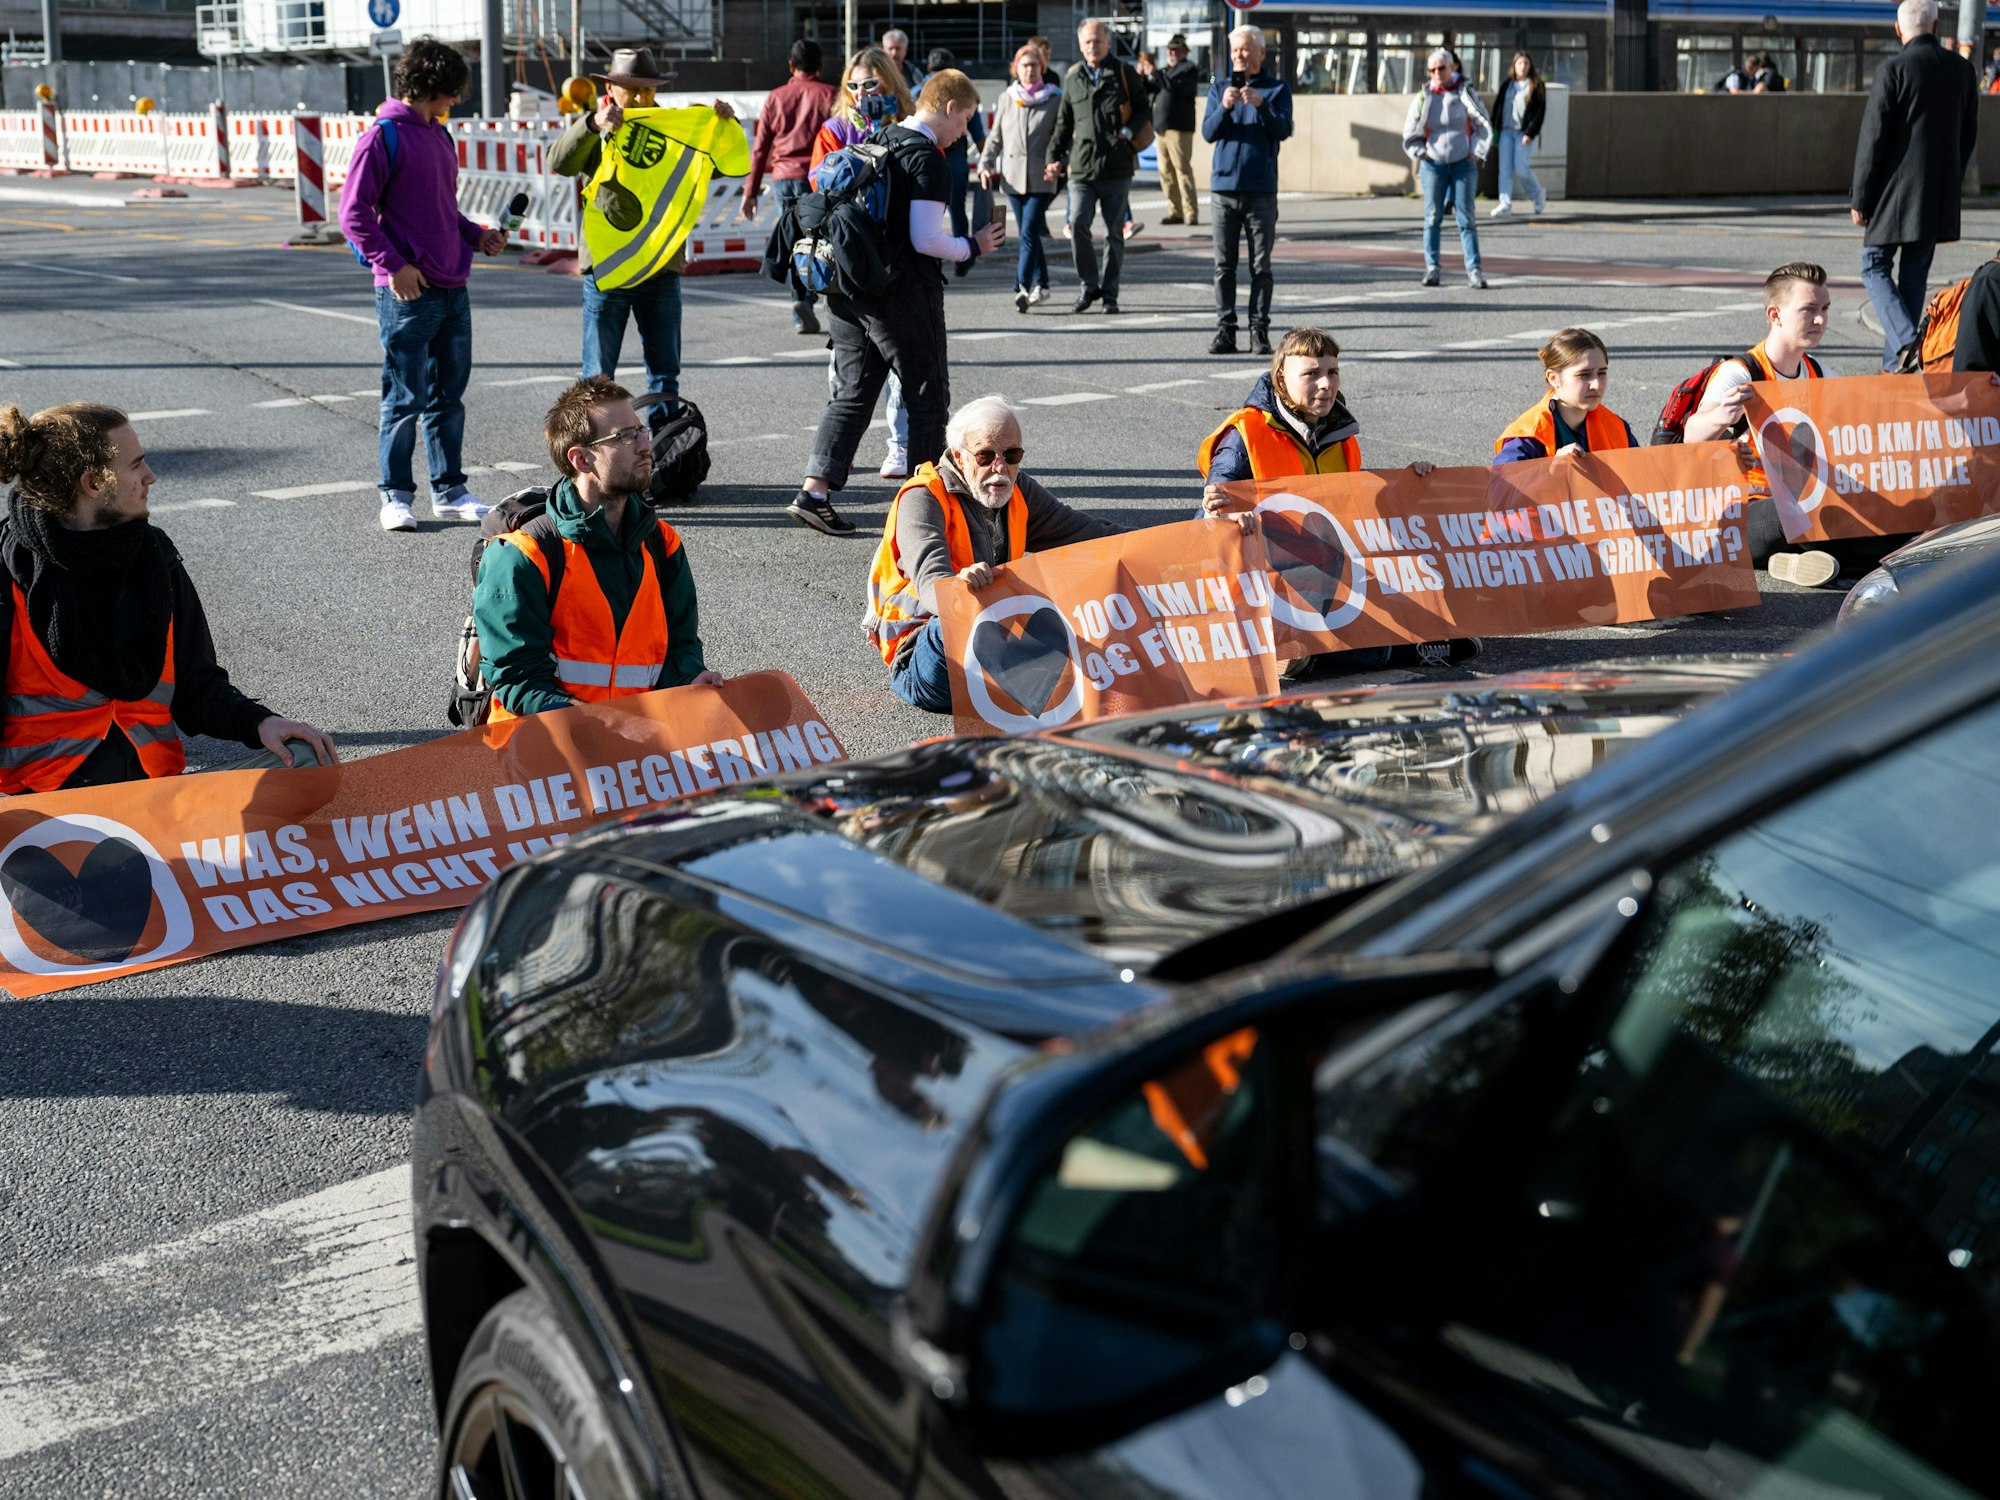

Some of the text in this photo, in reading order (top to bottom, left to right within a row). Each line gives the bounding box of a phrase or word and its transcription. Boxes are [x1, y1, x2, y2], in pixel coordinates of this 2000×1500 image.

[1828, 416, 2000, 457] 100 KM/H UND
[1834, 455, 1971, 495] 9€ FÜR ALLE
[1353, 484, 1742, 553] WAS, WENN DIE REGIERUNG
[1371, 525, 1742, 596] DAS NICHT IM GRIFF HAT?
[1072, 593, 1138, 643] 100
[1135, 576, 1236, 618] KM/H
[1086, 642, 1140, 691] 9€
[1138, 620, 1207, 668] FÜR
[180, 720, 842, 888] WAS, WENN DIE REGIERUNG
[202, 881, 332, 933] DAS
[331, 846, 501, 907] NICHT
